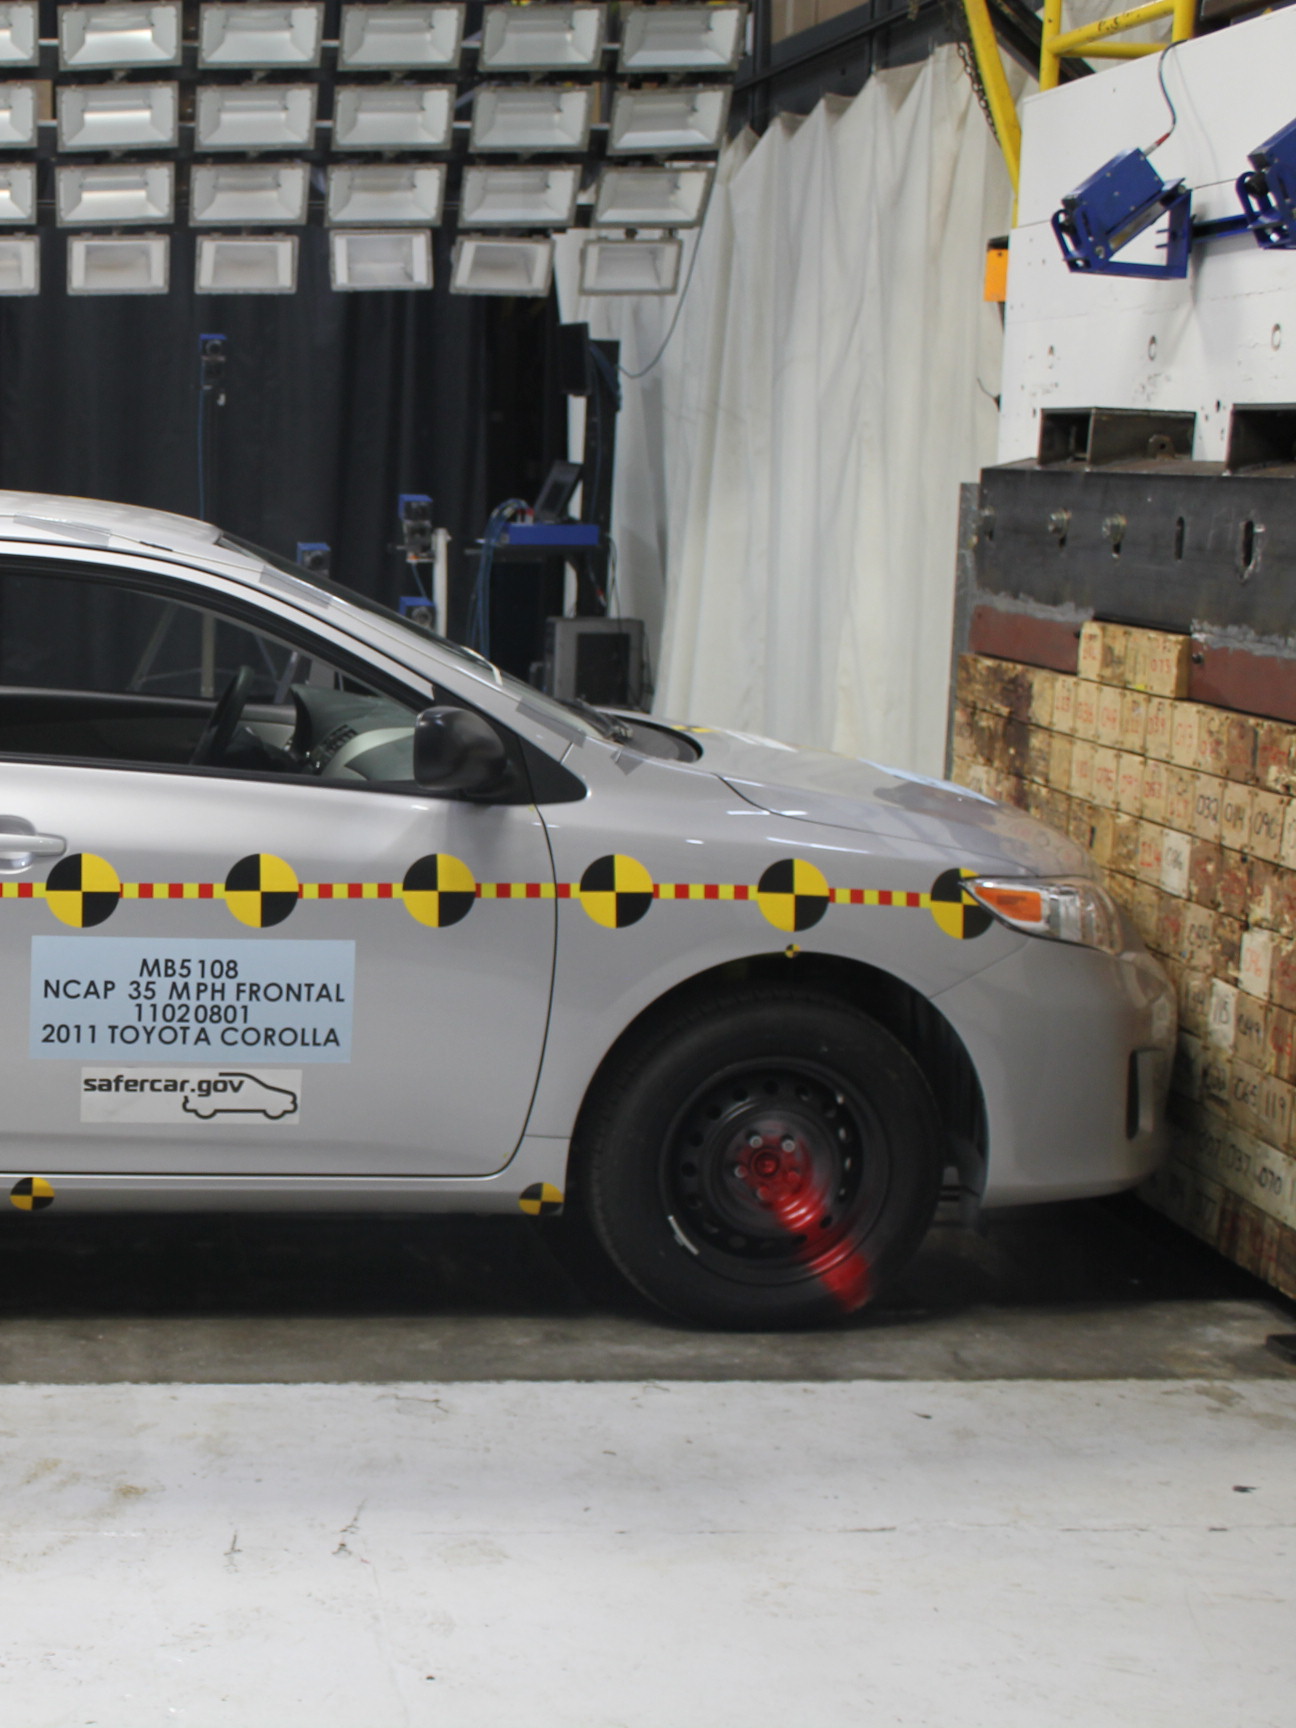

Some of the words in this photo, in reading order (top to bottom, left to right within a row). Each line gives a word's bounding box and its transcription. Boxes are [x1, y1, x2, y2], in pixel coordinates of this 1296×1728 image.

[139, 958, 239, 979] MB5108
[43, 979, 116, 1000] NCAP
[128, 980, 156, 1000] 35
[168, 981, 225, 1001] MPH
[235, 982, 345, 1003] FRONTAL
[134, 1003, 248, 1024] 11020801
[41, 1024, 97, 1044] 2011
[108, 1025, 211, 1046] TOYOTA
[220, 1027, 340, 1047] COROLLA
[83, 1074, 245, 1098] safercar.gov
